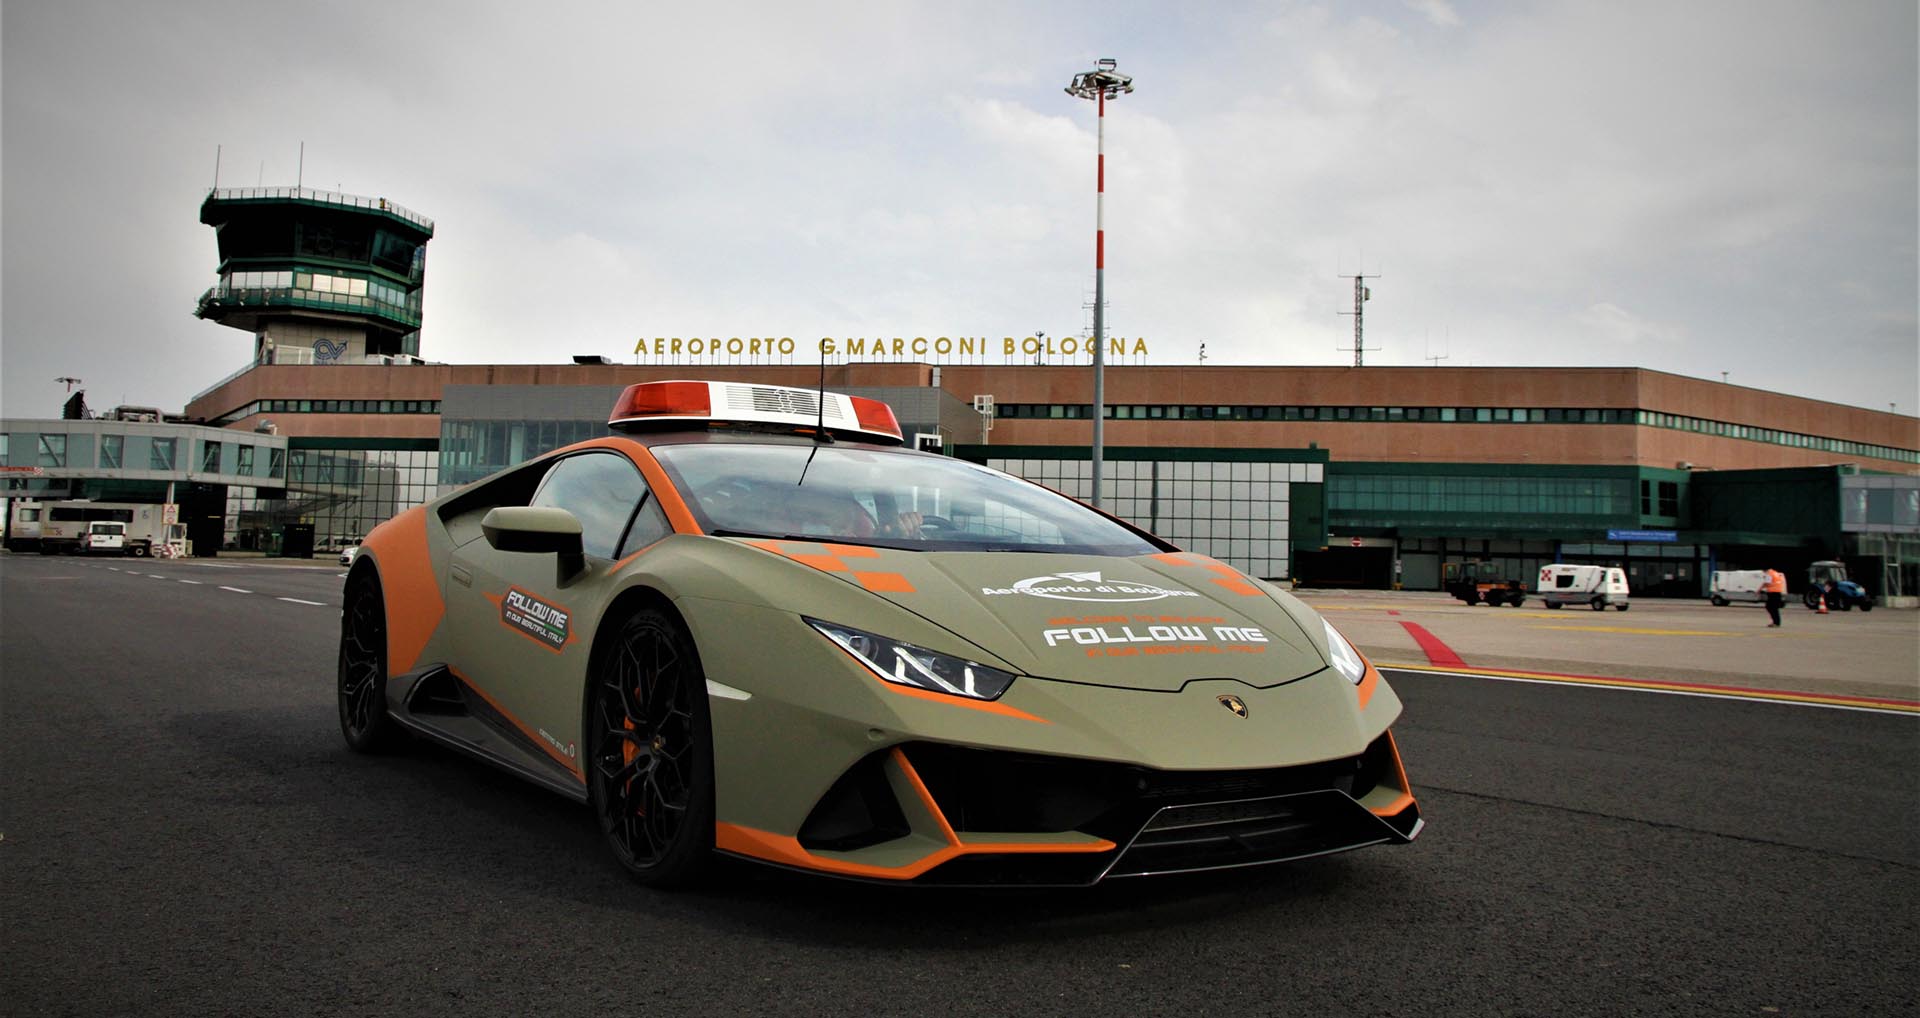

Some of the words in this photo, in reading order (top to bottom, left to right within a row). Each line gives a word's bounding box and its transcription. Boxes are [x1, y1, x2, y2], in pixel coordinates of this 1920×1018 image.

[634, 337, 795, 355] AEROPORTO
[818, 337, 986, 355] G.MARCONI
[1096, 585, 1115, 593] di
[507, 591, 550, 620] FOLLOW
[547, 610, 568, 629] ME
[547, 631, 564, 645] ITALY
[1044, 626, 1208, 647] FOLLOW
[1213, 626, 1269, 643] ME
